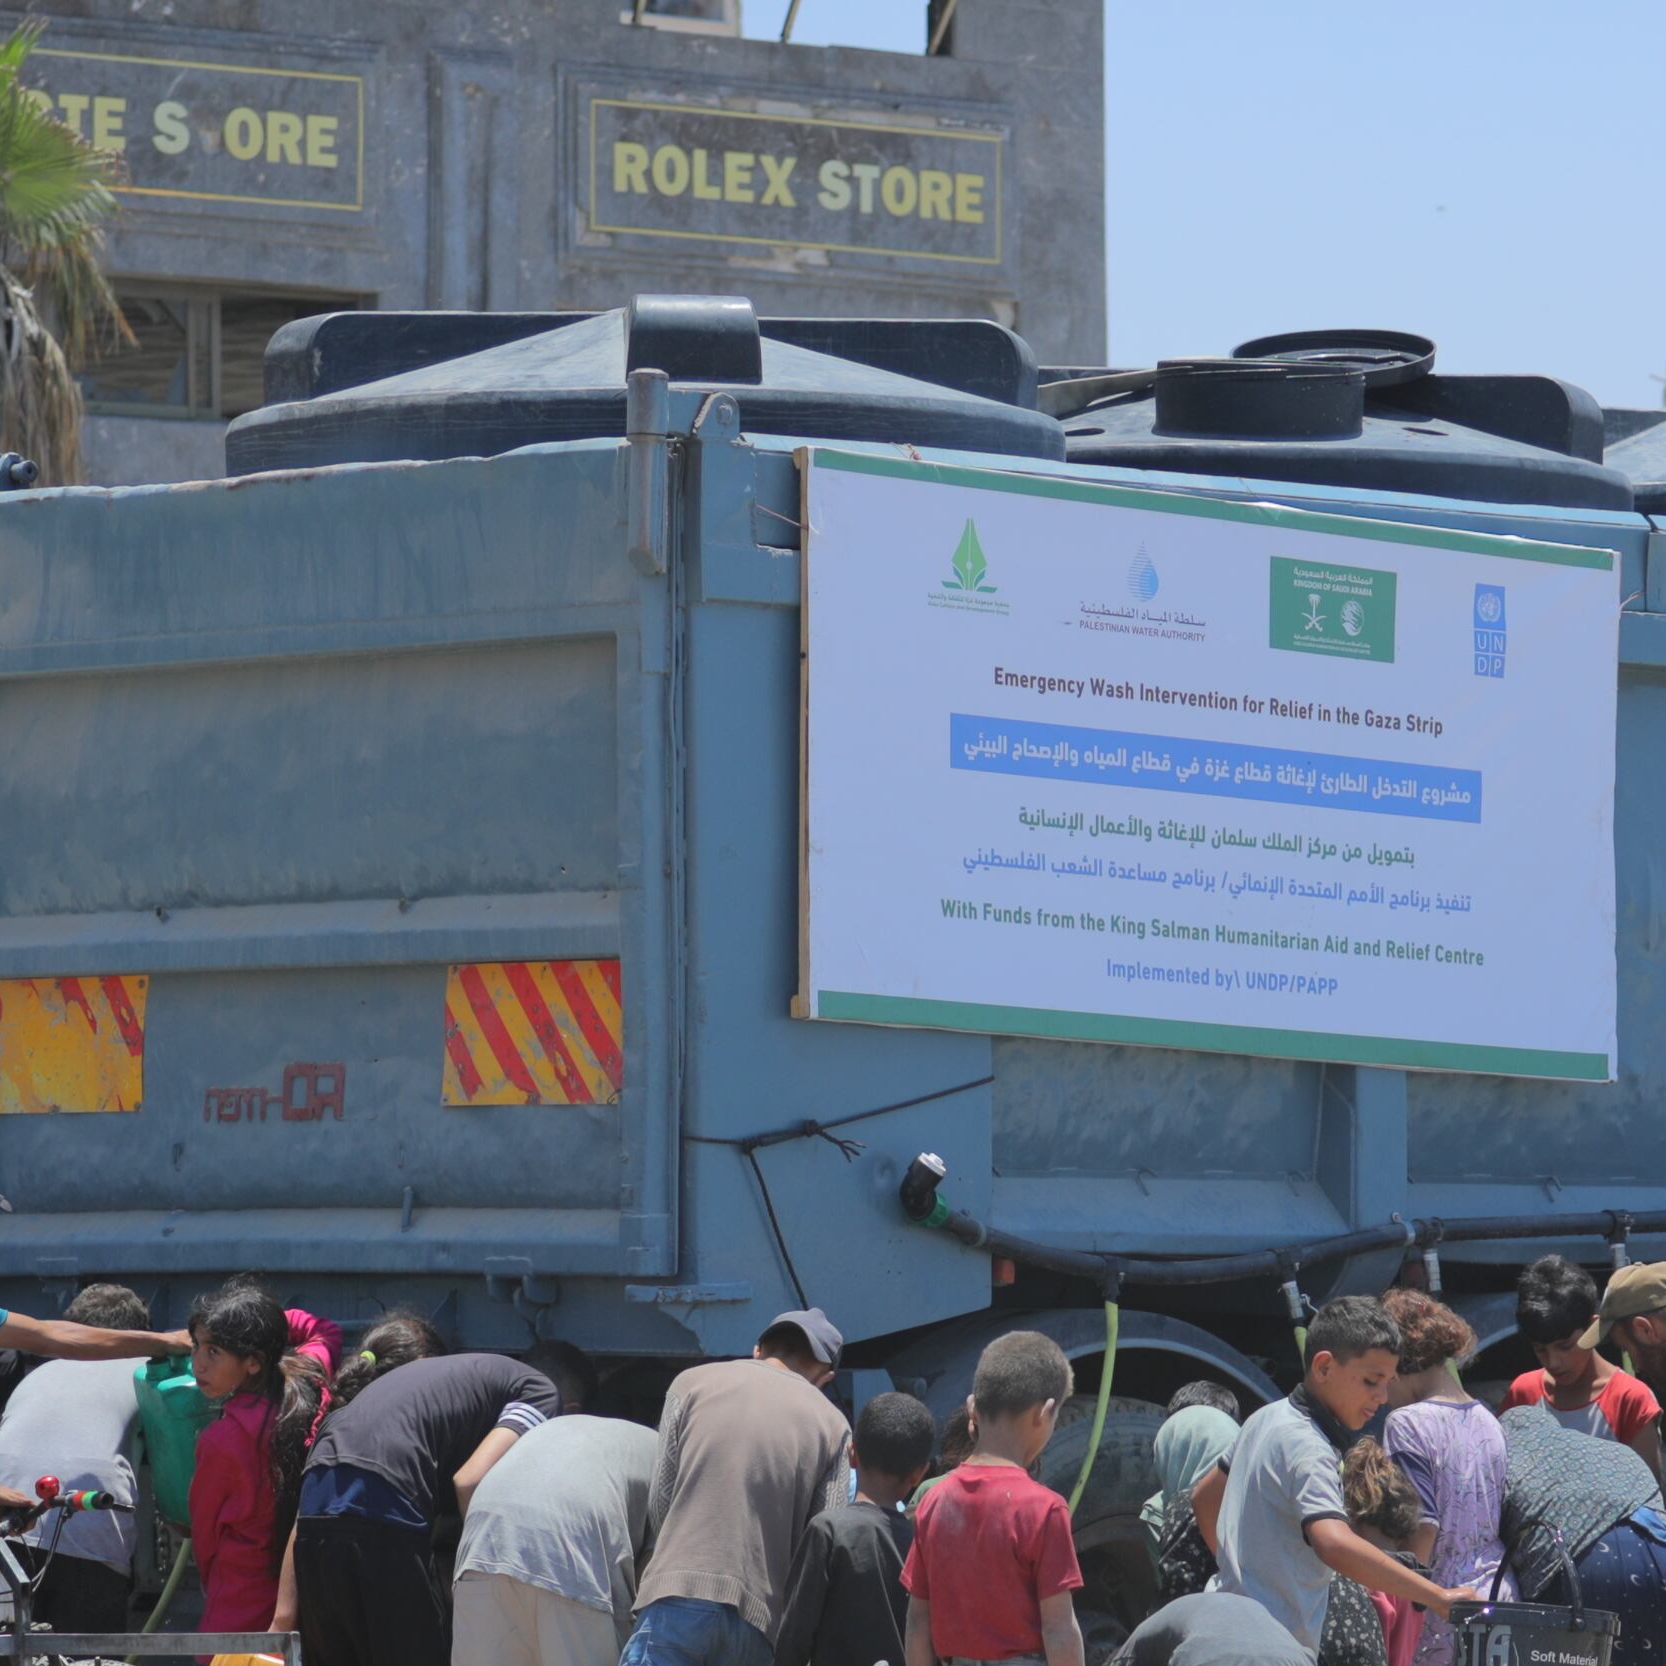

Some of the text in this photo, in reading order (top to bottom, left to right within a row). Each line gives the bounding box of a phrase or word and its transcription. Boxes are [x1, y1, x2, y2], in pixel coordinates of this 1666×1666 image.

[152, 100, 338, 168] SORE
[613, 142, 984, 223] ROLEX STORE
[1293, 579, 1373, 597] KINGDOM OF SAUDI ARABIA
[1079, 620, 1206, 642] PALESTINIAN WATER AUTHORITY
[994, 667, 1443, 738] Emergency Wash Intervention for Relief in the Gaza Strip
[964, 732, 1471, 806] مشروع التدخل الطارئ لإغاثة قطاع غزة في قطاع المياه والإصحاح البيئي
[1019, 806, 1415, 868] بتمويل من مركز الملك سلمان للإغاثة والأعمال الإنسانية
[963, 849, 1046, 874] الفلسطيني
[1051, 855, 1103, 878] الشعب
[1108, 861, 1167, 883] مساعدة
[1172, 868, 1216, 893] برنامج
[1288, 878, 1342, 901] المتحدة
[1347, 882, 1385, 906] الأمم
[1389, 889, 1430, 913] برنامج
[1436, 893, 1471, 915] تنفيذ
[941, 899, 1484, 966] With Funds from the King Salman Humanitarian Aid and Relief Centre
[1107, 958, 1210, 987] Implemented
[1246, 971, 1338, 996] UNDP/PAPP
[1530, 1649, 1598, 1666] Soft Material
